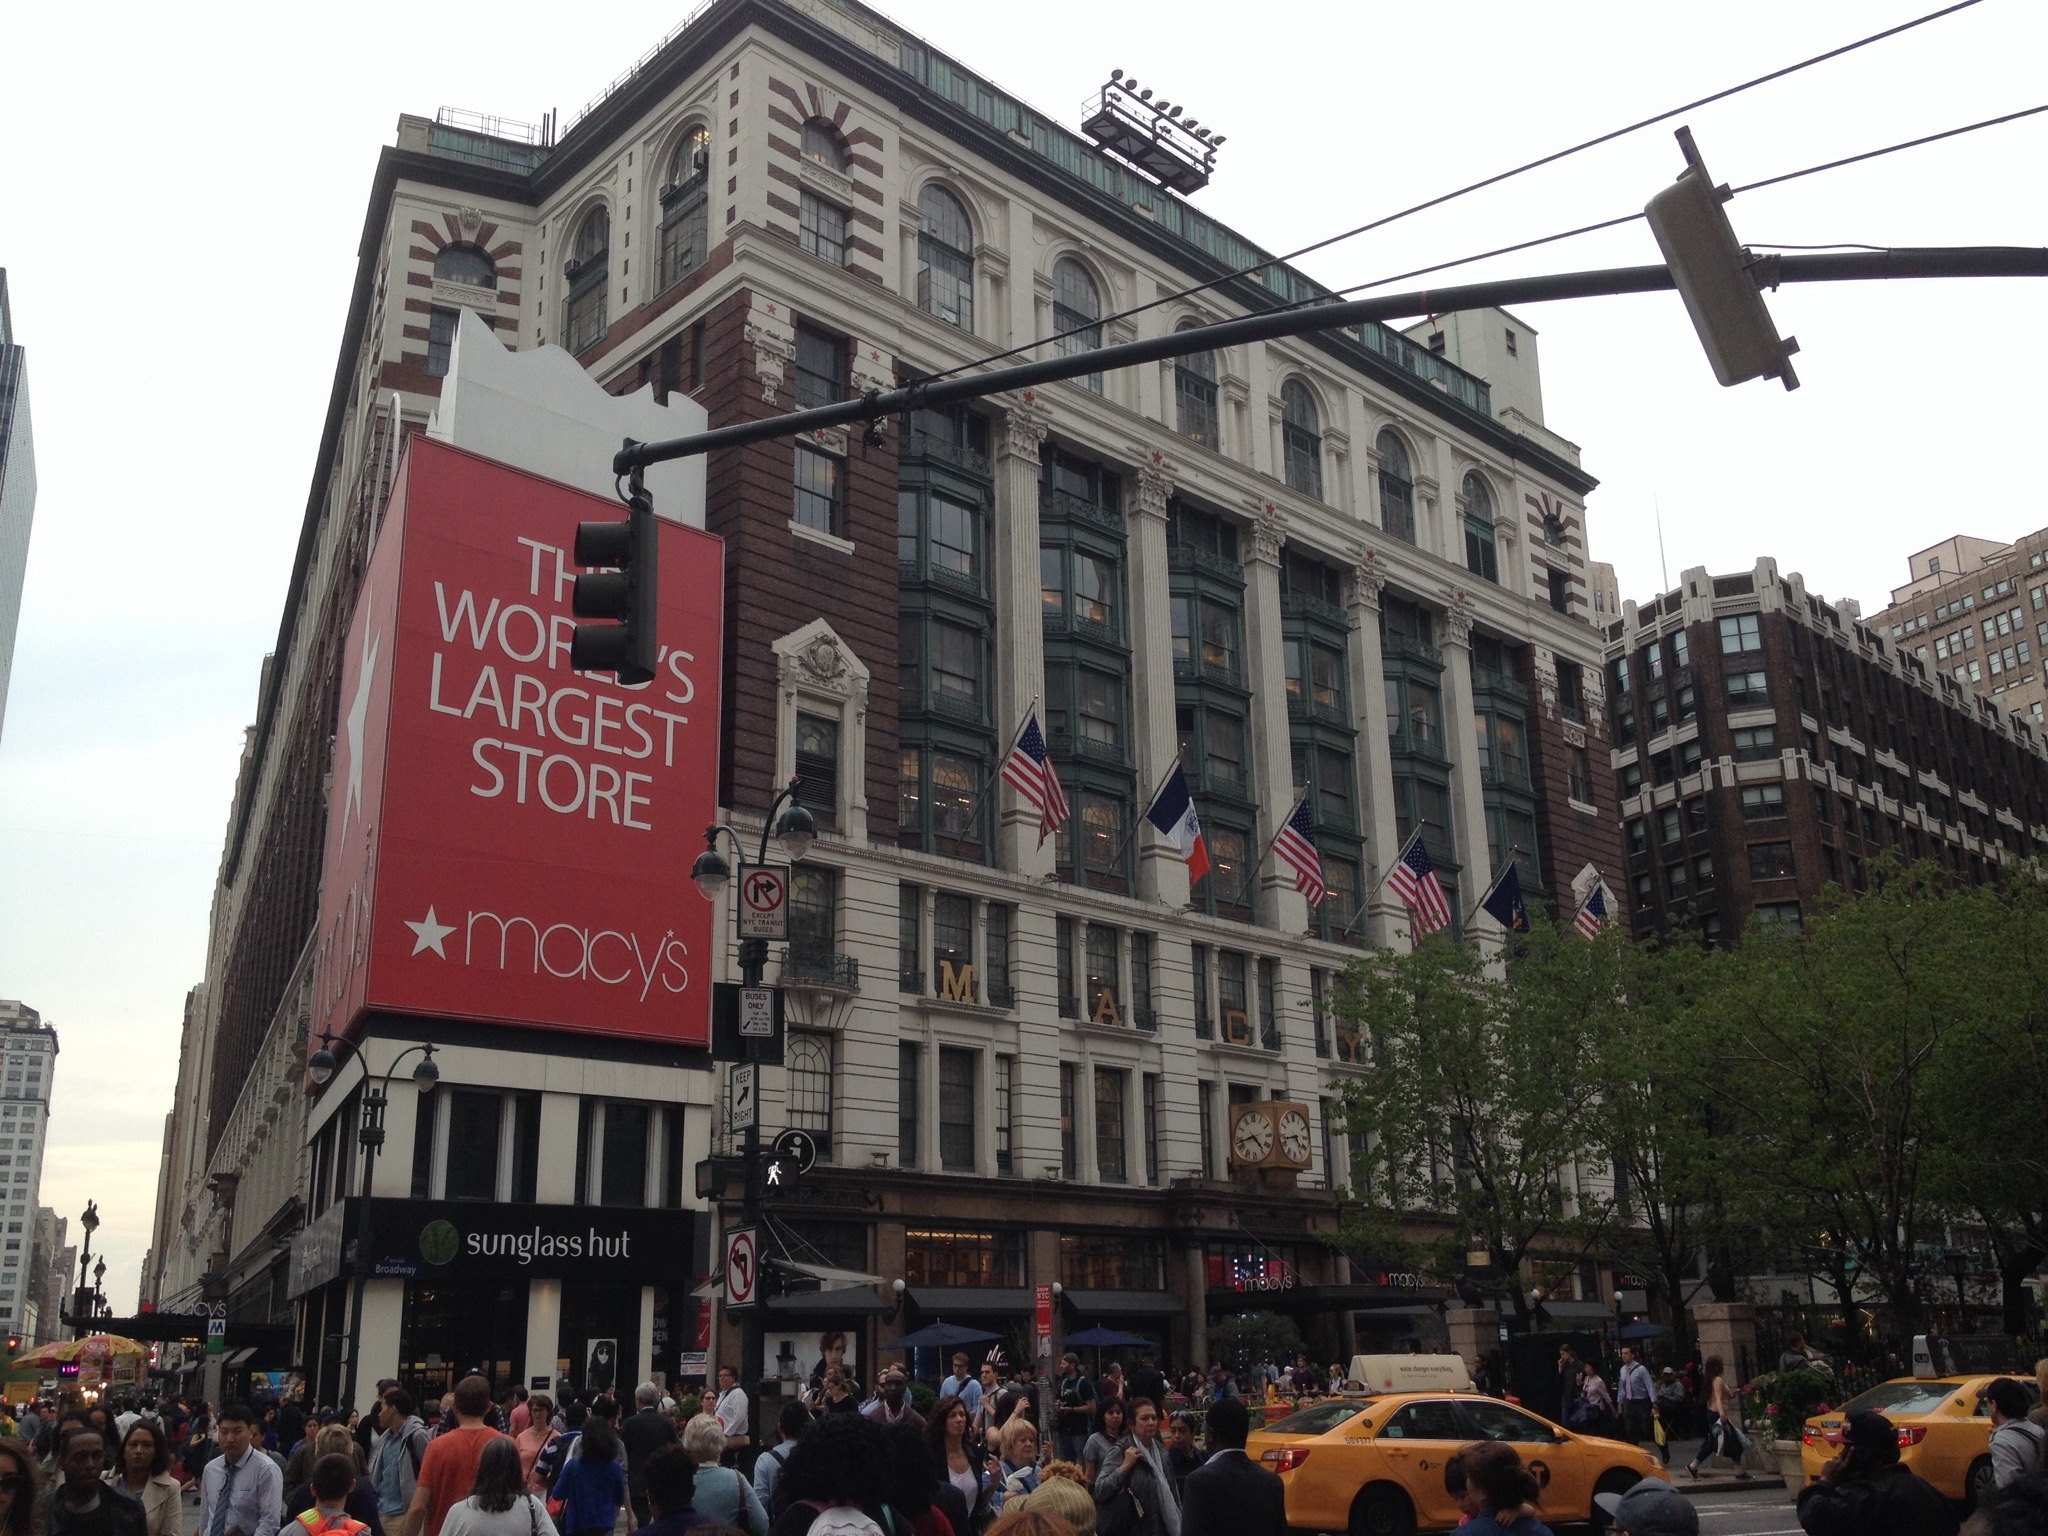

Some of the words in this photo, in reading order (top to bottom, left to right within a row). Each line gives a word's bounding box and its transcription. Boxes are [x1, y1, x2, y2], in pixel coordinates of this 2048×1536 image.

[518, 536, 623, 603] TH
[434, 581, 695, 704] WOR'S
[429, 652, 688, 767] LARGEST
[470, 738, 652, 831] STORE
[465, 910, 689, 1002] macy's
[745, 992, 767, 1001] BUSES
[747, 1002, 764, 1010] ONLY
[940, 960, 973, 1001] M
[1093, 988, 1123, 1027] A
[1226, 1010, 1251, 1046] C
[735, 1070, 752, 1085] KEEP
[734, 1108, 752, 1123] RIGHT
[467, 1226, 582, 1265] sunglass
[589, 1227, 631, 1259] hut
[375, 1263, 417, 1276] Broadway
[209, 1321, 224, 1334] M
